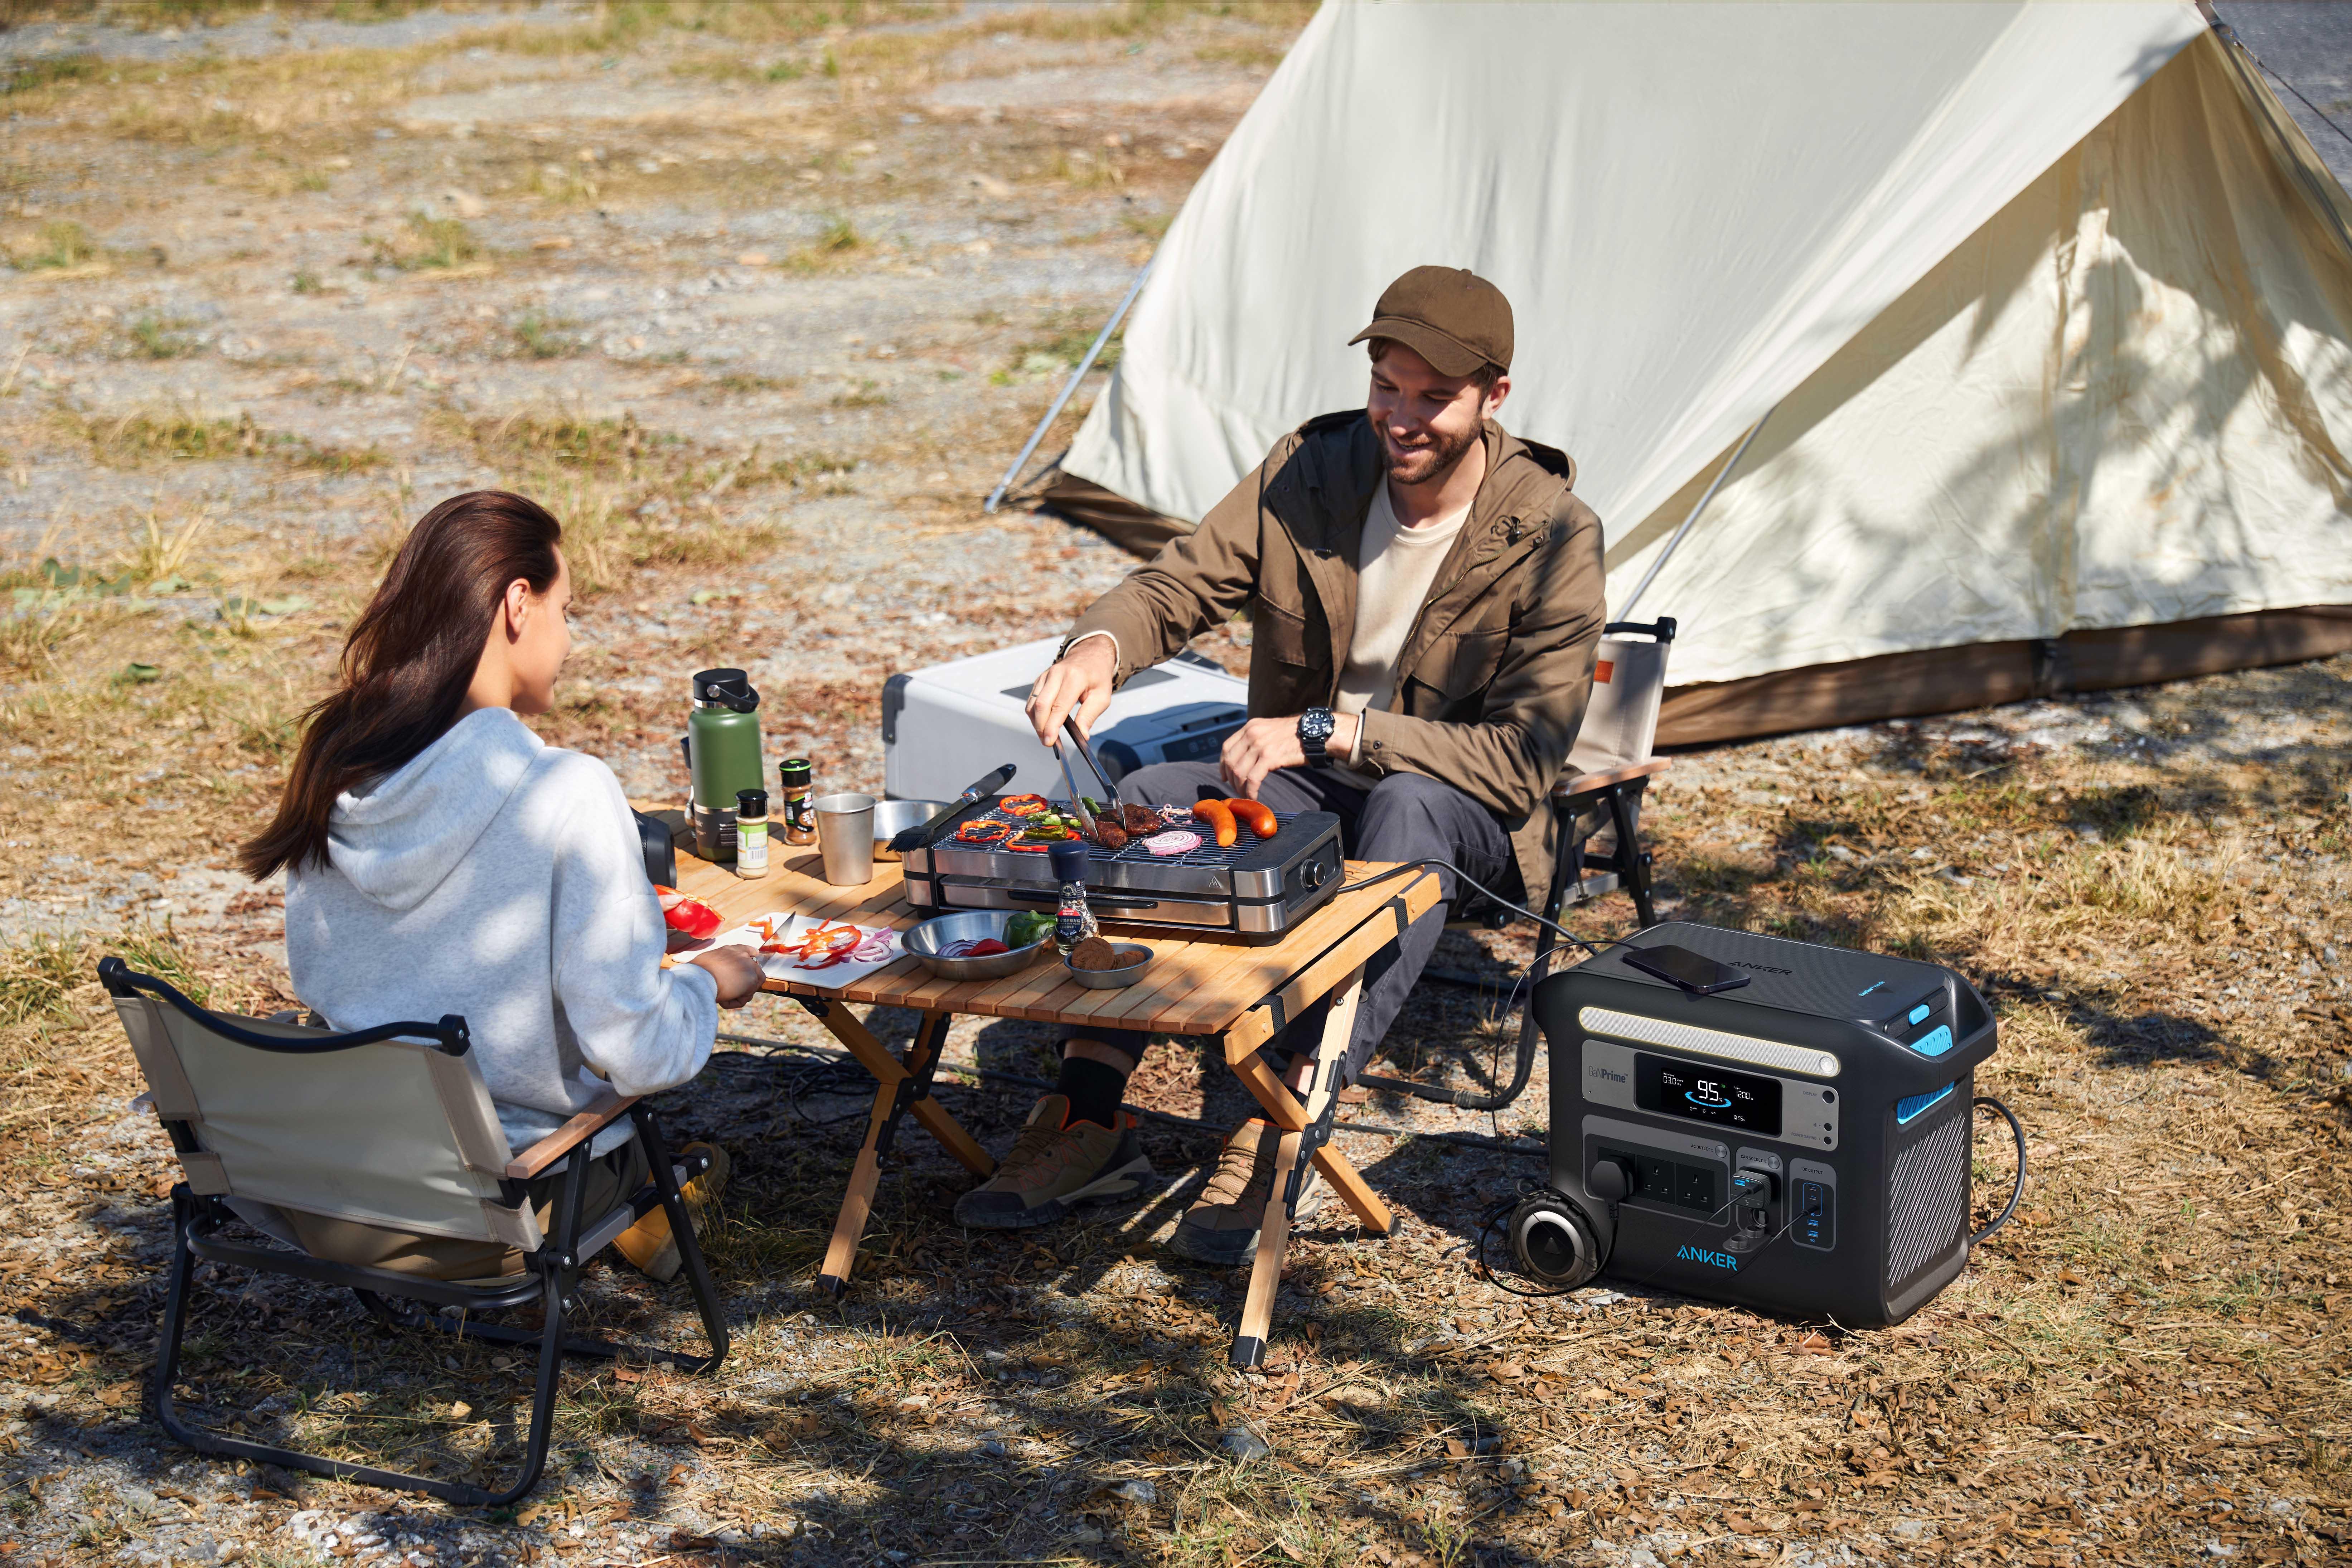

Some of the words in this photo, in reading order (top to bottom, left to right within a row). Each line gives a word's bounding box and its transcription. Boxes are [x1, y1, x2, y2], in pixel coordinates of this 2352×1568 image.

[1727, 962, 1792, 976] ANKER
[1664, 1076, 1676, 1085] 03.0
[1676, 1244, 1738, 1271] ANKER
